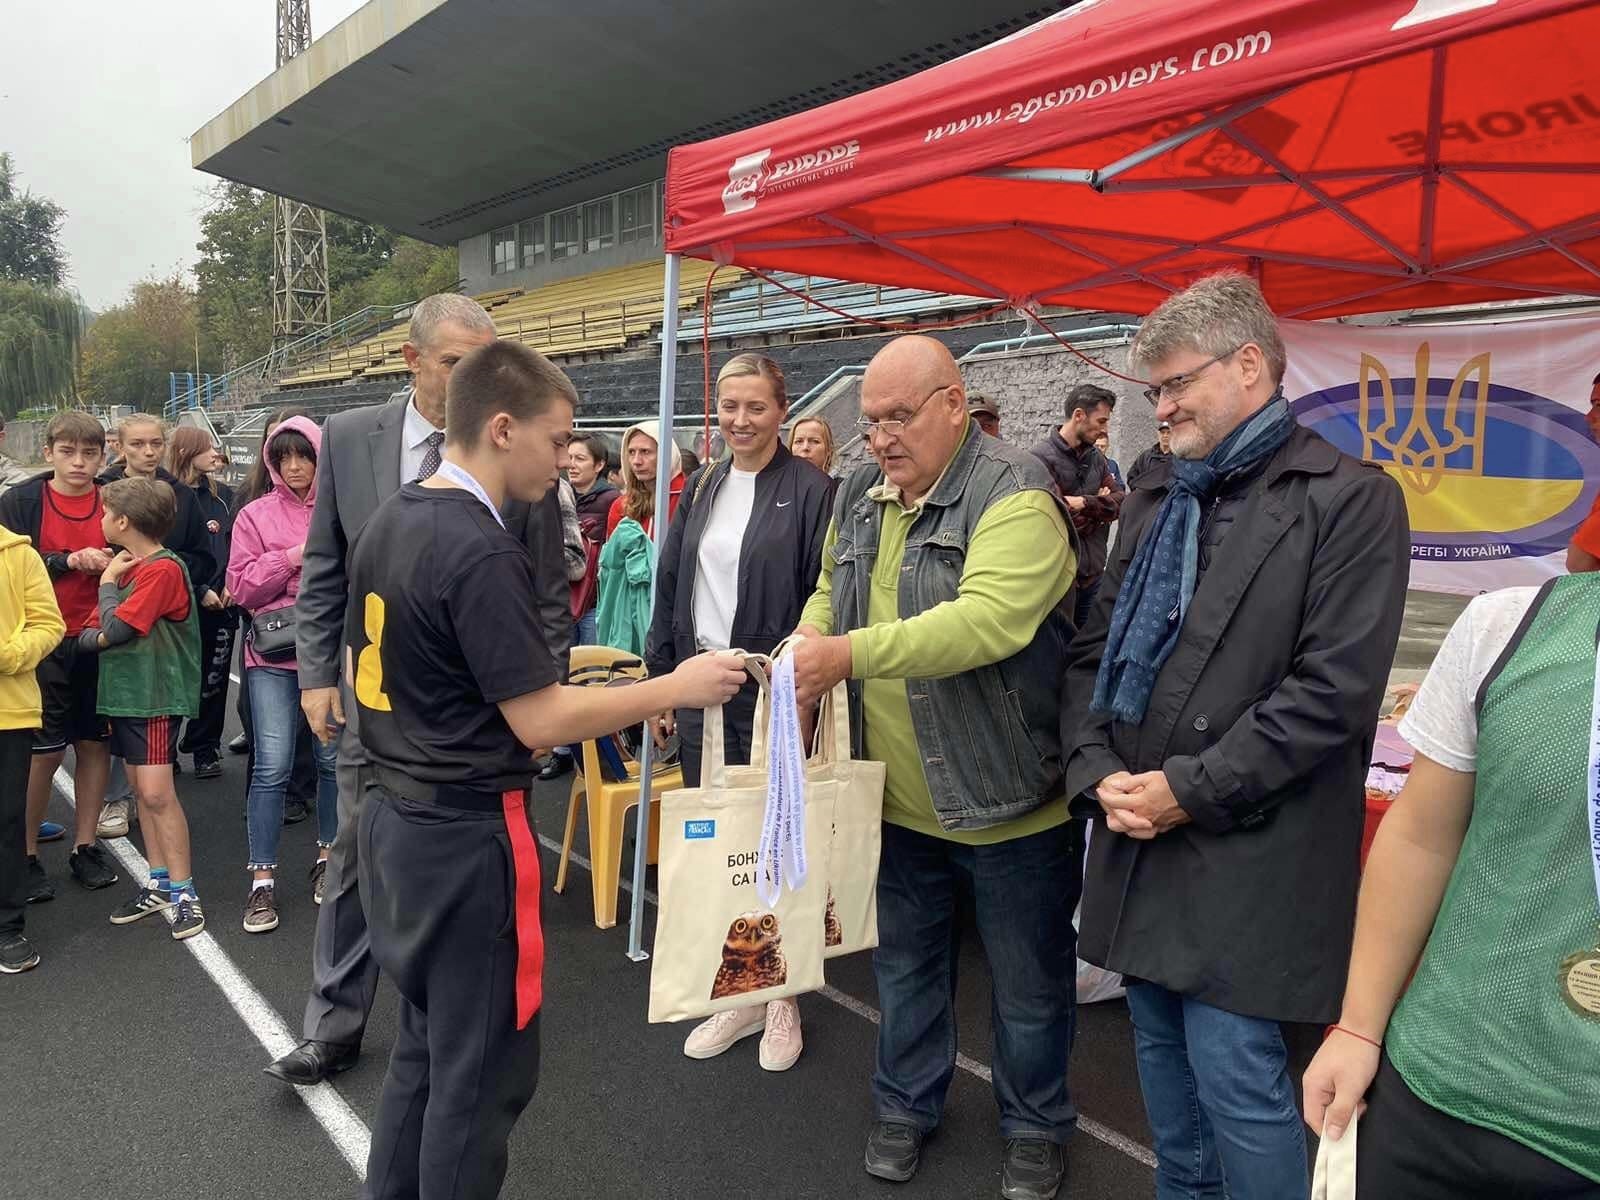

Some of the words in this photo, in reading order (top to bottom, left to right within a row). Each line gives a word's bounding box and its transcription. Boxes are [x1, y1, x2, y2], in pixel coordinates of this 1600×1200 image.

[925, 30, 1273, 143] www.agsmovers.com
[769, 140, 861, 180] EUROPE
[725, 173, 760, 196] AGS
[767, 172, 821, 193] INTERNATIONAL
[823, 161, 855, 177] MOVERS
[1411, 545, 1448, 558] РЕГБІ
[1454, 543, 1512, 558] УКРАЇНИ
[732, 872, 750, 887] СА
